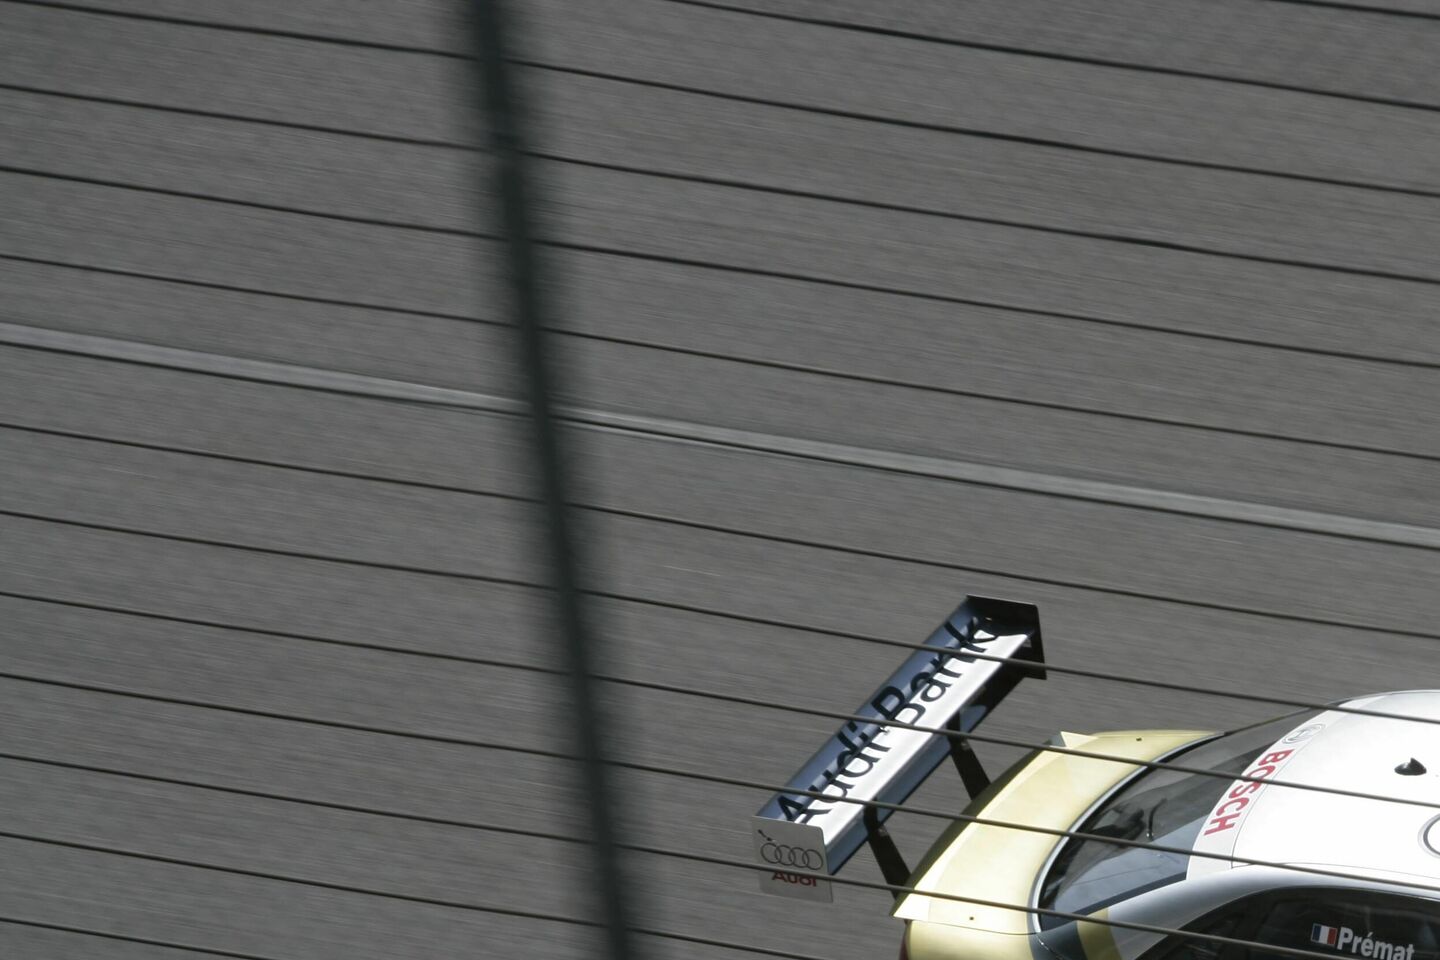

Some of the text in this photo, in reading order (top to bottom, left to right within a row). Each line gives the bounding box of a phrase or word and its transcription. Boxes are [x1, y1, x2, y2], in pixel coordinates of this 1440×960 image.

[777, 616, 999, 824] Audi Bank
[1204, 749, 1295, 836] BOSCH
